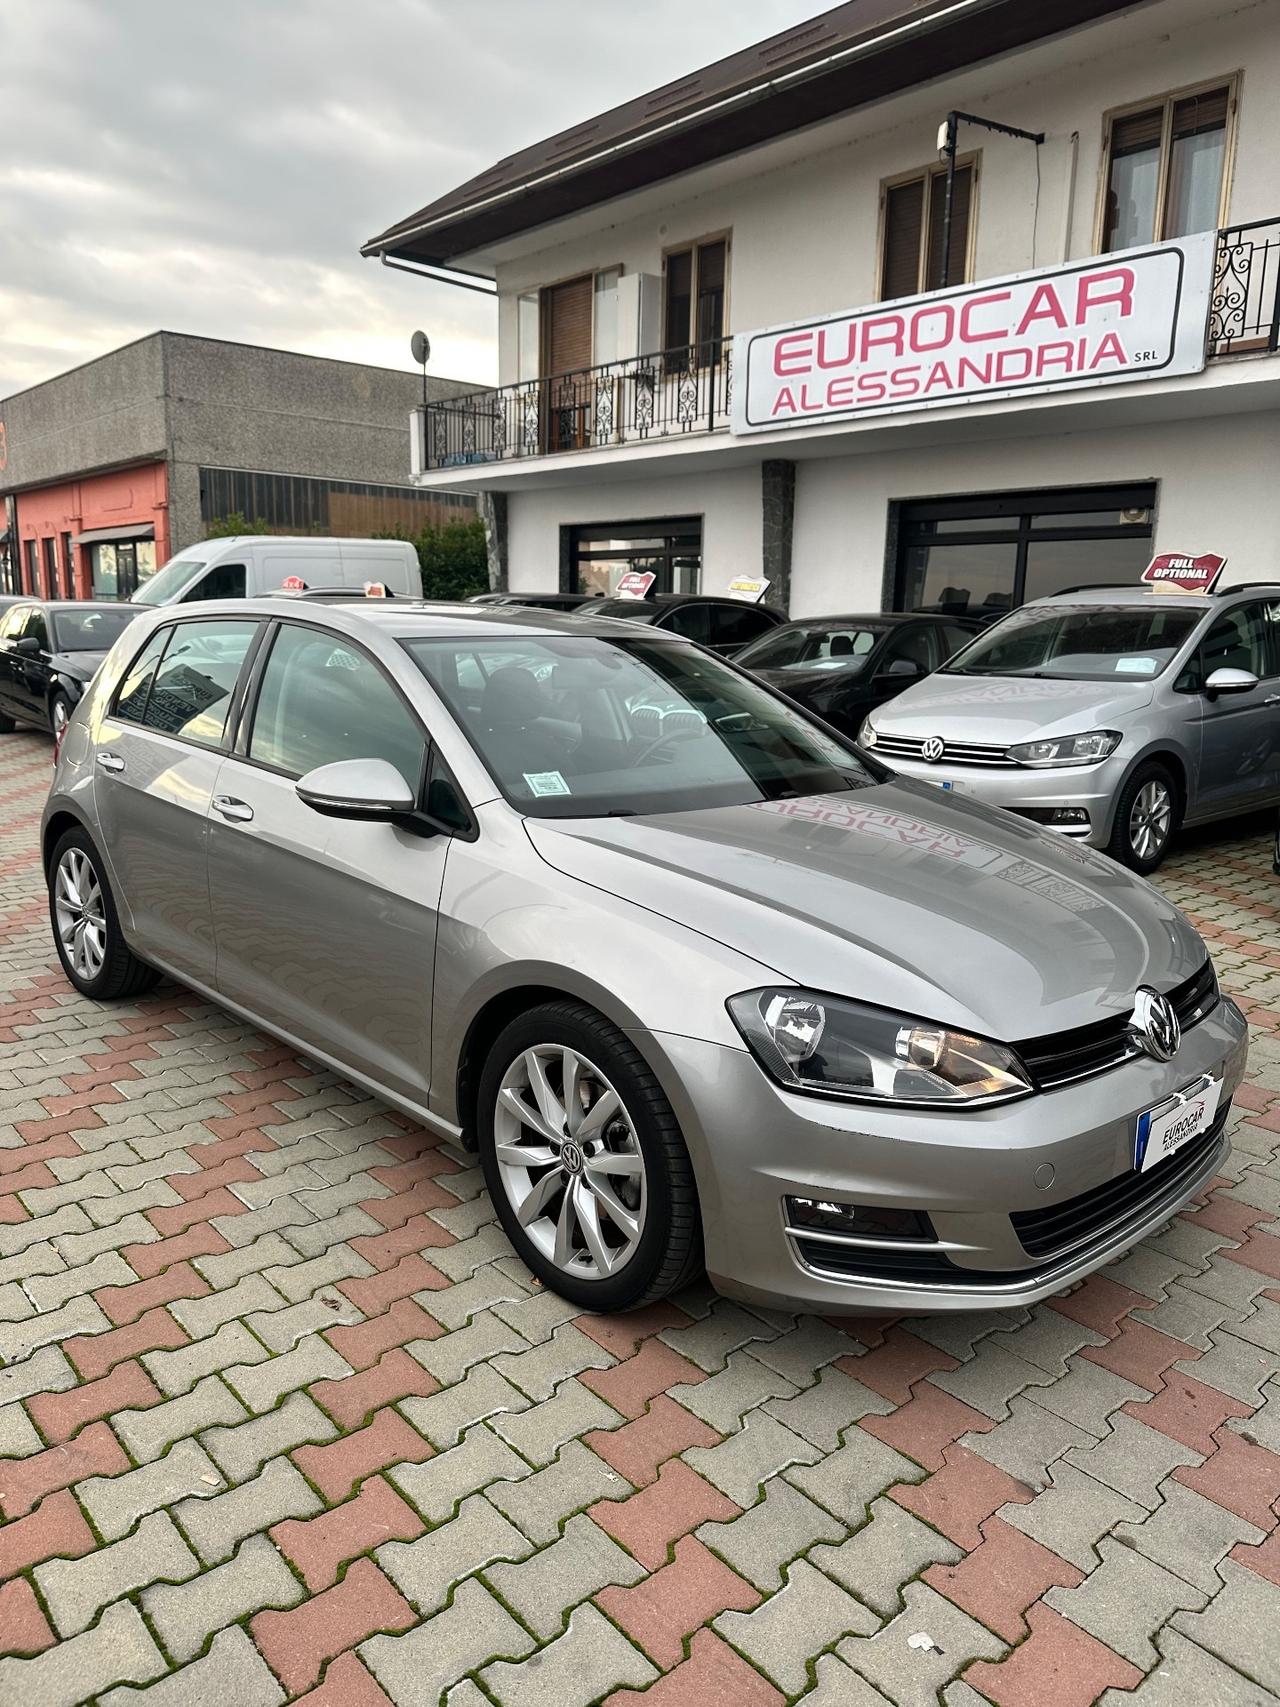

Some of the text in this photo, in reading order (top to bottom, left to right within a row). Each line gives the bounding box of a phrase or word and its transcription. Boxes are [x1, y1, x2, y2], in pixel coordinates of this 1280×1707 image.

[773, 267, 1136, 378] EUROCAR
[771, 331, 1158, 417] ALESSANDRIA SRL
[1153, 568, 1208, 578] OPTIONAL
[1168, 559, 1193, 568] FULL
[1162, 1106, 1205, 1145] EUROCAR
